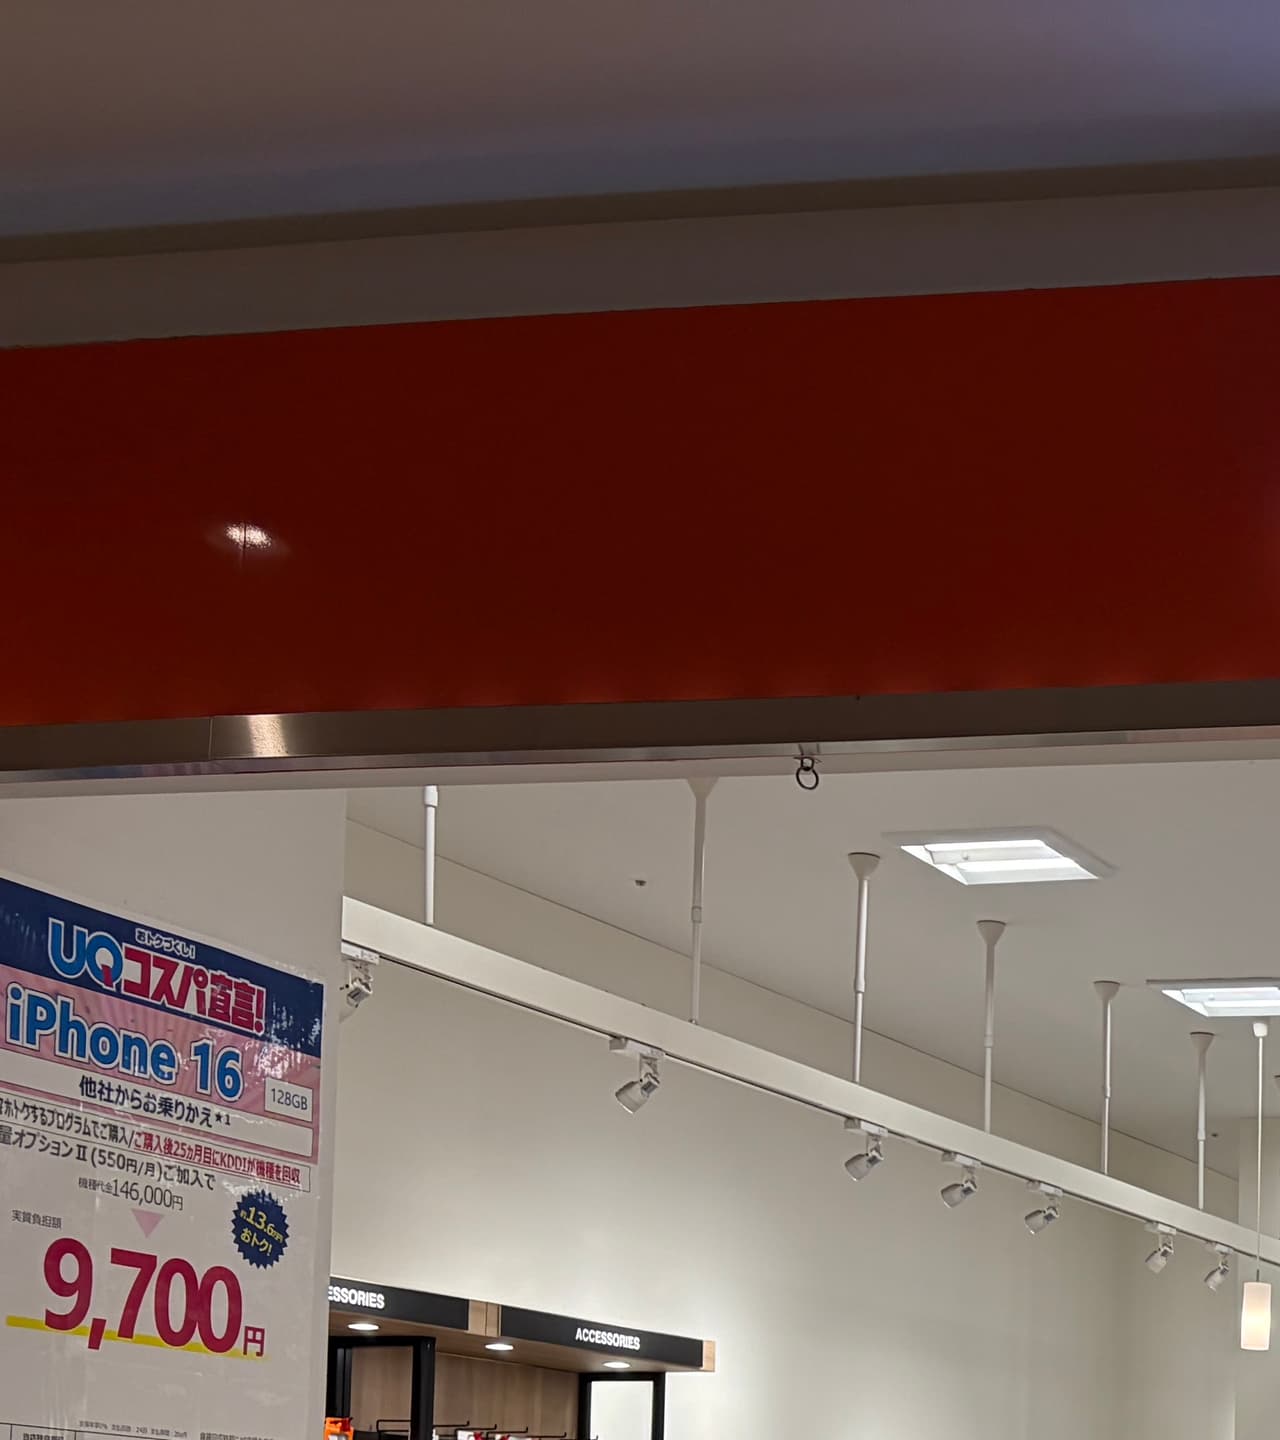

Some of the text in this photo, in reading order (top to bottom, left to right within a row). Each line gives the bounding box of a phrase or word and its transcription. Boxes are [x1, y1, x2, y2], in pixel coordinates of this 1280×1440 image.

[6, 983, 245, 1102] iPhone 16
[270, 1086, 309, 1112] 128GB
[43, 1237, 266, 1357] 9,700円
[328, 1284, 386, 1310] ESSORIES
[575, 1326, 641, 1351] ACCESSORIES
